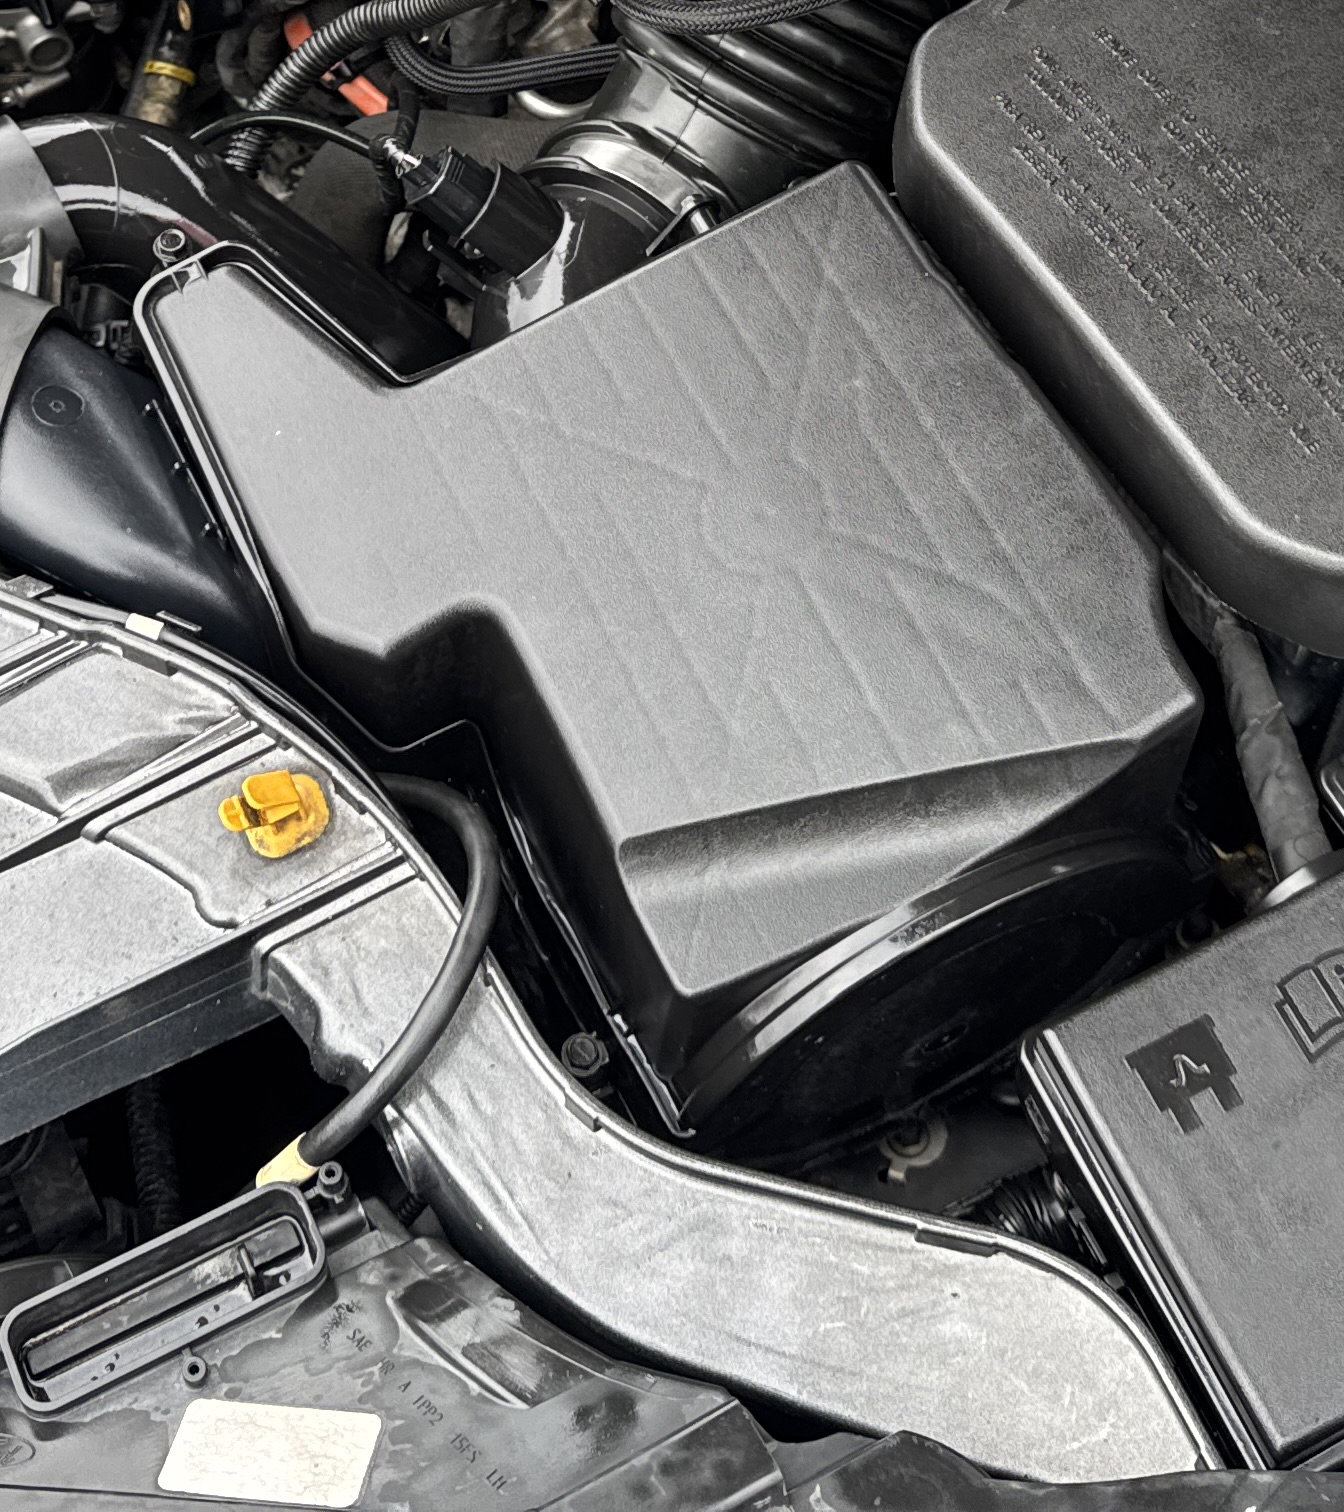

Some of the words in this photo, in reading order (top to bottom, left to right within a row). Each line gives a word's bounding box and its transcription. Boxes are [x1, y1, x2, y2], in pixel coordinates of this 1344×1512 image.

[346, 1328, 373, 1353] SAE
[398, 1380, 412, 1394] A
[486, 1468, 507, 1491] LH
